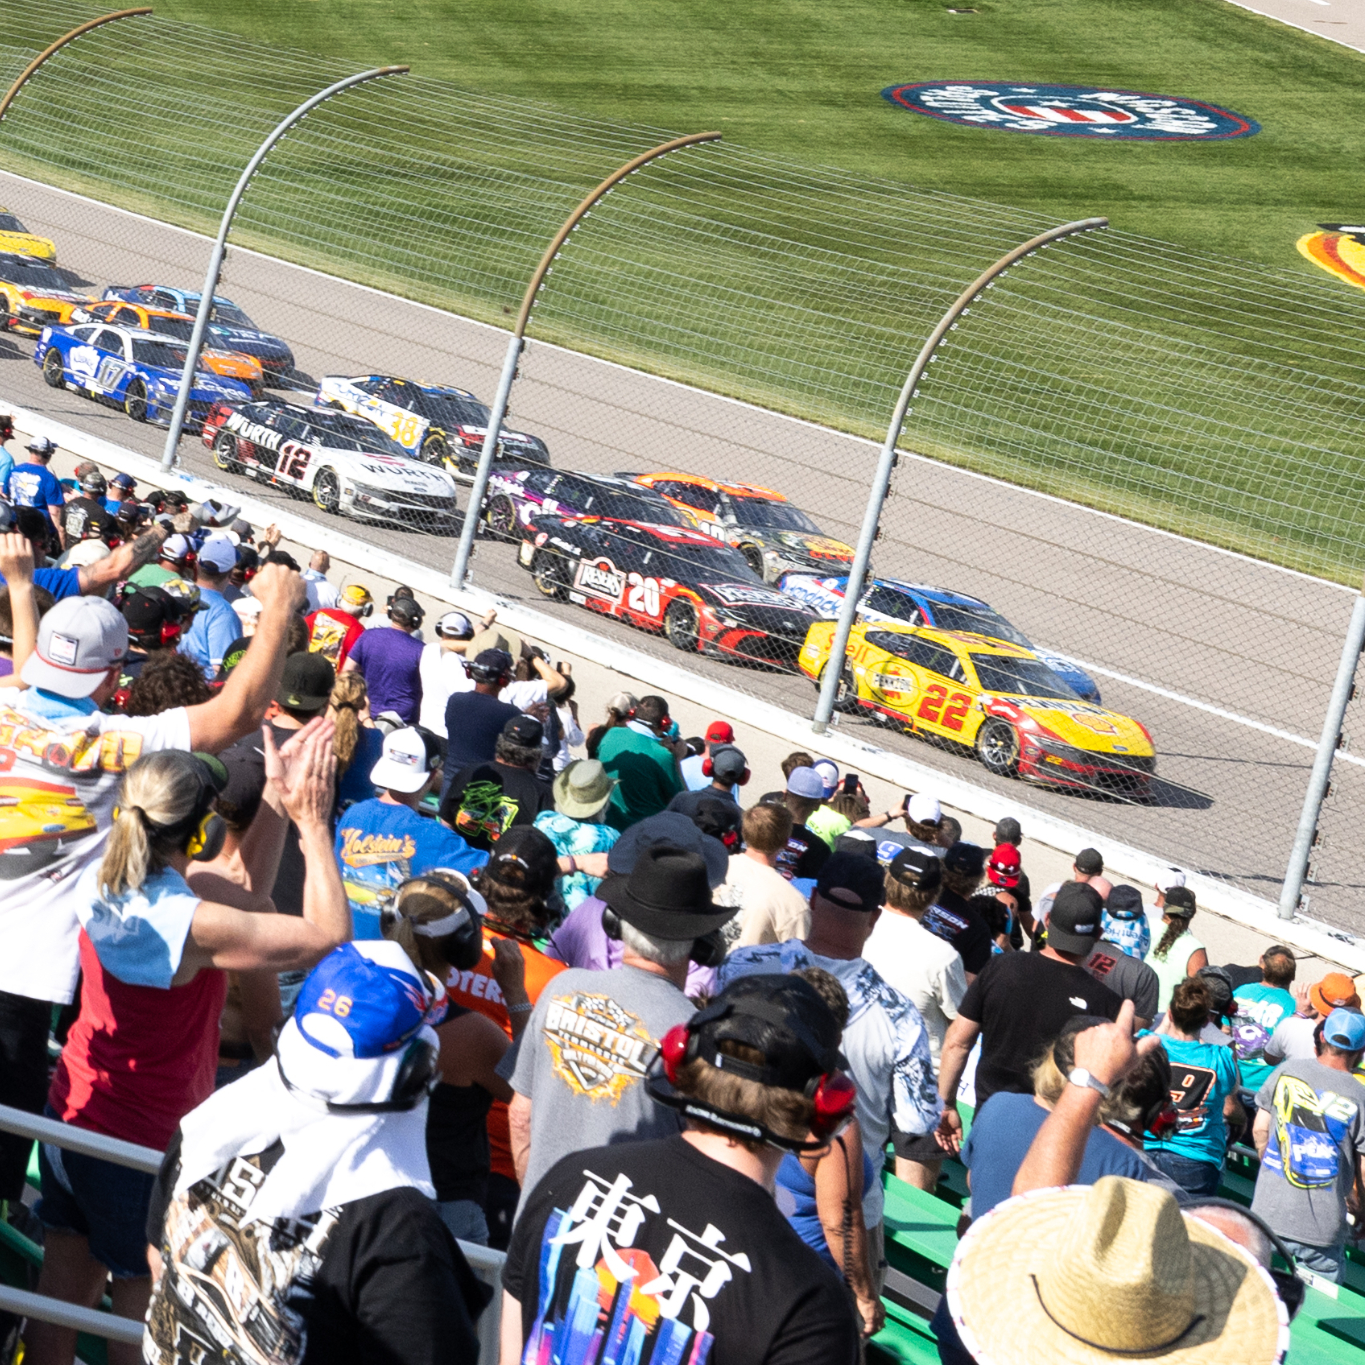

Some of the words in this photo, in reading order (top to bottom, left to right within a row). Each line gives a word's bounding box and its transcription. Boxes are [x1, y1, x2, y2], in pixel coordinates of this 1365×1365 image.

[390, 411, 419, 447] 38
[277, 441, 312, 481] 12
[627, 572, 661, 617] 20
[825, 632, 870, 665] Sell
[917, 683, 973, 733] 22
[317, 988, 354, 1018] 26
[545, 999, 648, 1073] BRISTOL
[1319, 1089, 1359, 1122] 12
[548, 1169, 753, 1334] 東京
